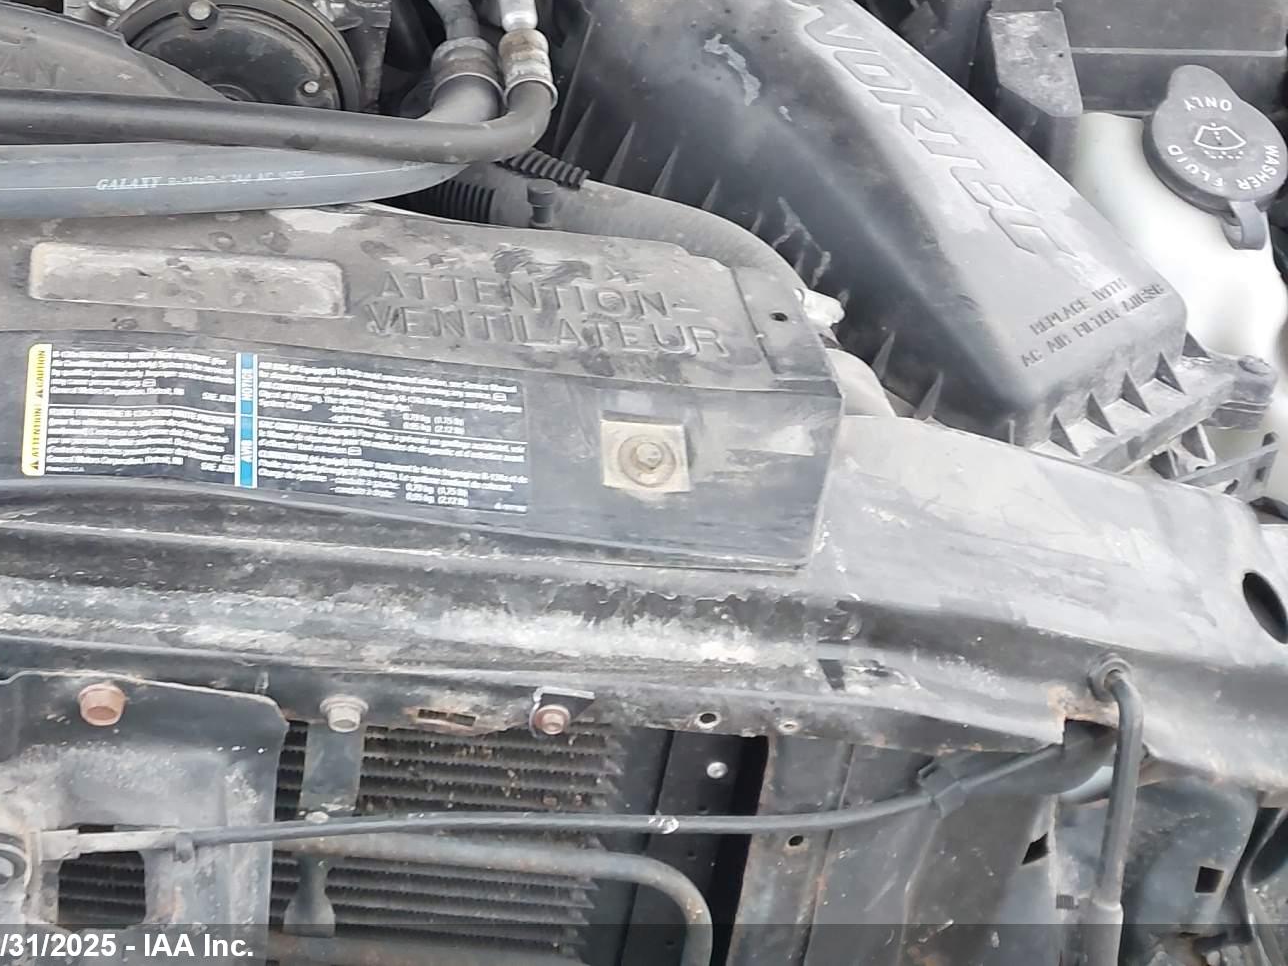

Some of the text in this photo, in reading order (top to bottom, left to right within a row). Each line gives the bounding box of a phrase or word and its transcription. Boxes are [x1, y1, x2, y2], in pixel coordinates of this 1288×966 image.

[1167, 96, 1281, 191] WASHER FLUID ONLY
[366, 302, 730, 359] VENTILATEUR
[1029, 277, 1128, 336] REPLACE WITH
[1020, 349, 1043, 368] AC
[1045, 335, 1073, 354] AIR
[1073, 307, 1121, 338] FILTER
[36, 350, 45, 389] CAUTION
[241, 368, 253, 402] NOTICE
[32, 407, 42, 458] ATTENTION
